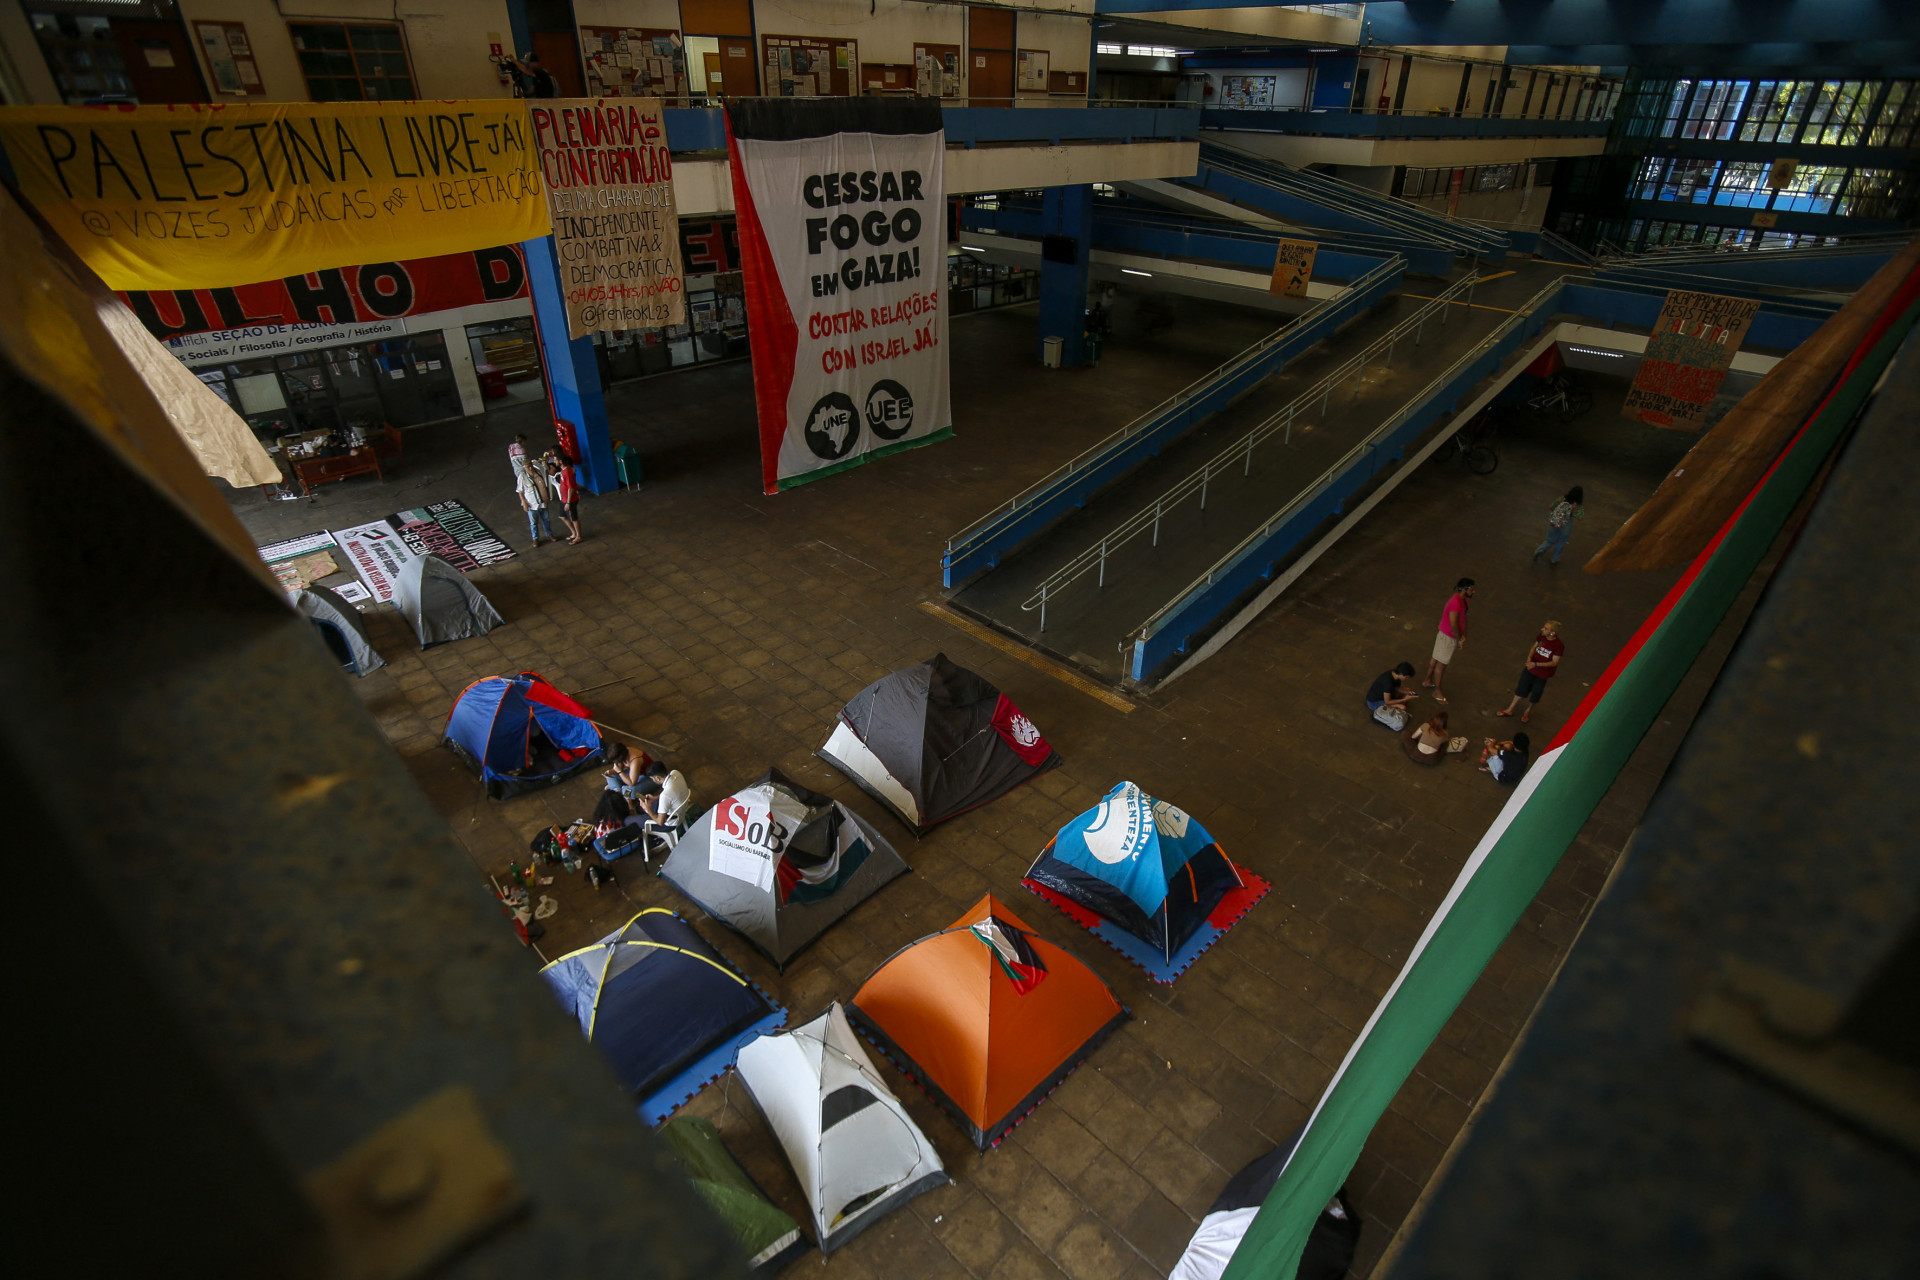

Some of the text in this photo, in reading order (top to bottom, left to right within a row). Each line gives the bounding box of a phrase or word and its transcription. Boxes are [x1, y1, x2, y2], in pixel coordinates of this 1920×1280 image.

[531, 99, 660, 149] PLENÁRIA DE
[37, 113, 526, 202] PALESTINA LIVRE JÁ!
[239, 189, 377, 233] JUDAICAS
[383, 187, 411, 215] POR
[415, 167, 540, 213] LIBERTAÇÃO
[803, 170, 924, 209] CESSAR
[806, 207, 922, 255] FOGO
[811, 246, 921, 298] EM GAZA!
[809, 288, 938, 340] CORTAR RELAÇÕES
[1665, 318, 1729, 345] PALESTINA
[190, 347, 229, 360] Sociais
[239, 339, 285, 353] Filosofia
[296, 331, 345, 345] Geografia
[355, 324, 392, 337] História
[822, 317, 939, 374] COM ISRAEL JÁ!
[823, 412, 848, 431] UNE
[869, 397, 914, 423] UEE
